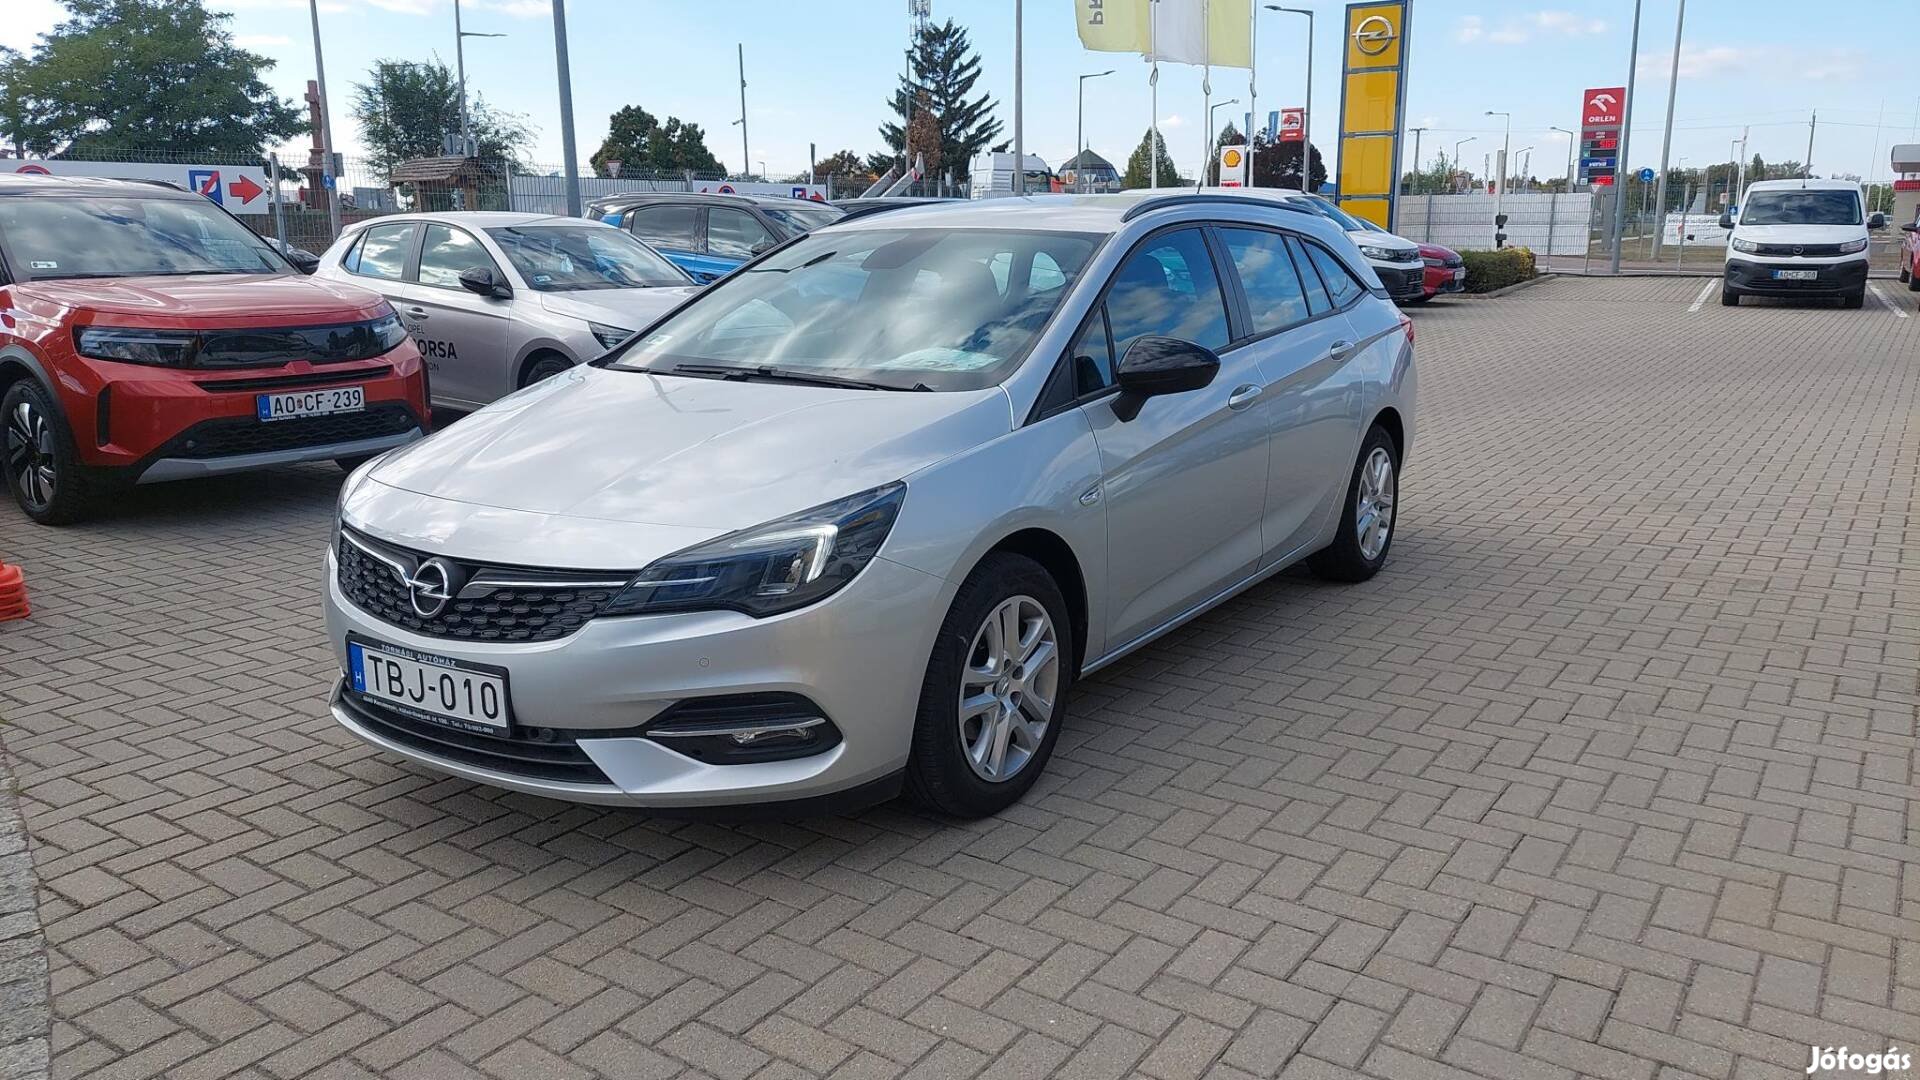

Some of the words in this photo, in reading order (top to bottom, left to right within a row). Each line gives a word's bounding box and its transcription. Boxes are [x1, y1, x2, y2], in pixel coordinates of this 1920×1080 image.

[1588, 115, 1616, 123] ORLEN
[407, 323, 425, 334] OPEL
[413, 338, 458, 360] ORSA
[367, 654, 499, 719] TBJ-010
